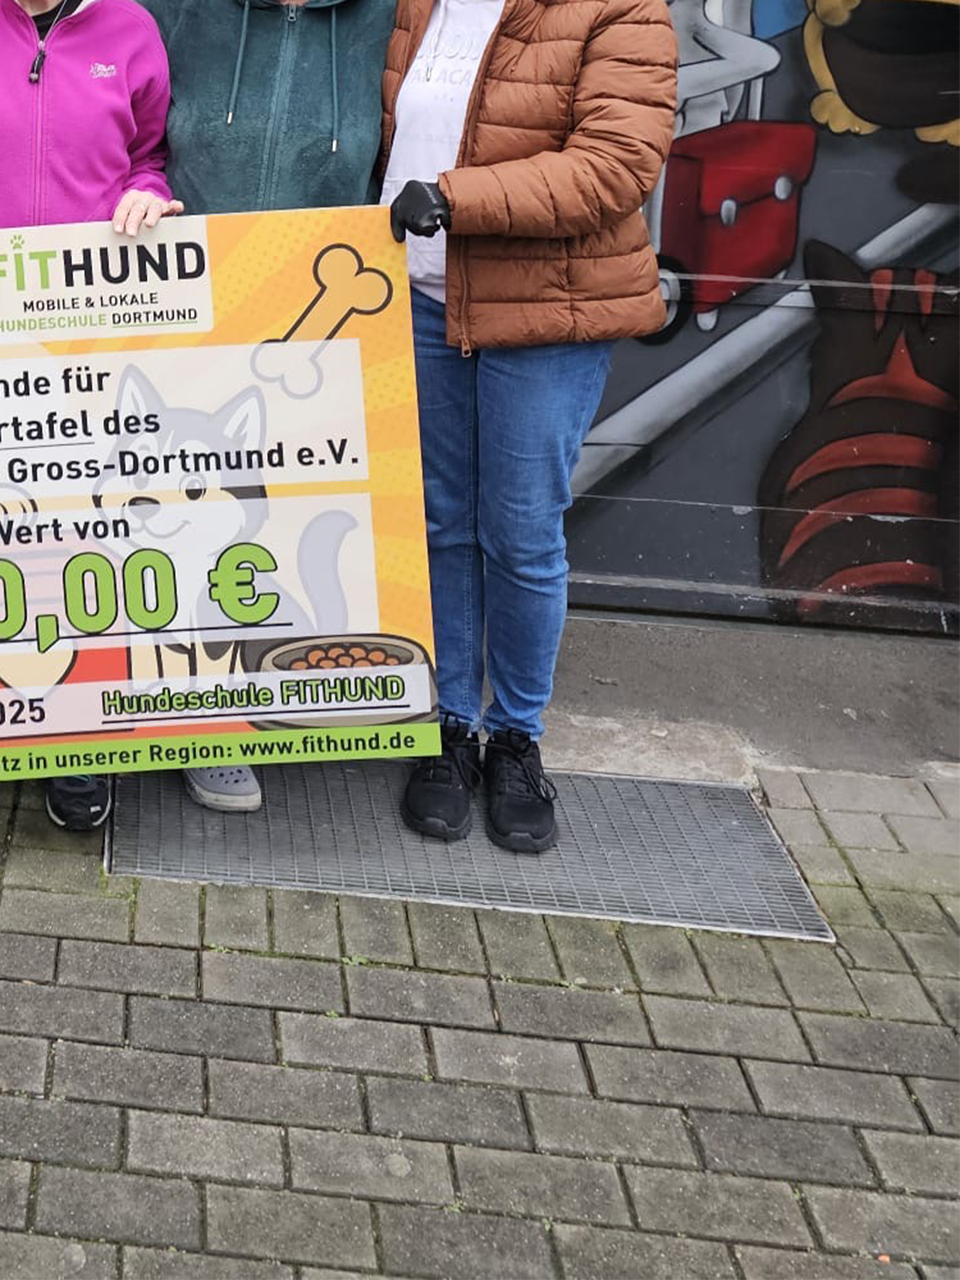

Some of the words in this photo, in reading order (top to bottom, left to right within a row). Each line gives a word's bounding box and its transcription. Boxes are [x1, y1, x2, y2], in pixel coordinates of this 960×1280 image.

[23, 297, 80, 313] MOBILE
[85, 296, 95, 308] &
[100, 292, 159, 307] LOKALE
[111, 307, 198, 326] DORTMUND
[62, 366, 111, 393] für
[103, 410, 161, 435] des
[7, 442, 285, 484] Gross-Dortmund
[296, 438, 359, 466] e.V.
[73, 519, 131, 540] von
[207, 542, 280, 626] €
[101, 681, 274, 716] Hundeschule
[280, 674, 406, 705] FITHUND
[28, 752, 48, 770] in
[55, 748, 141, 769] unserer
[149, 743, 233, 766] Region:
[239, 731, 416, 757] www.fithund.de
